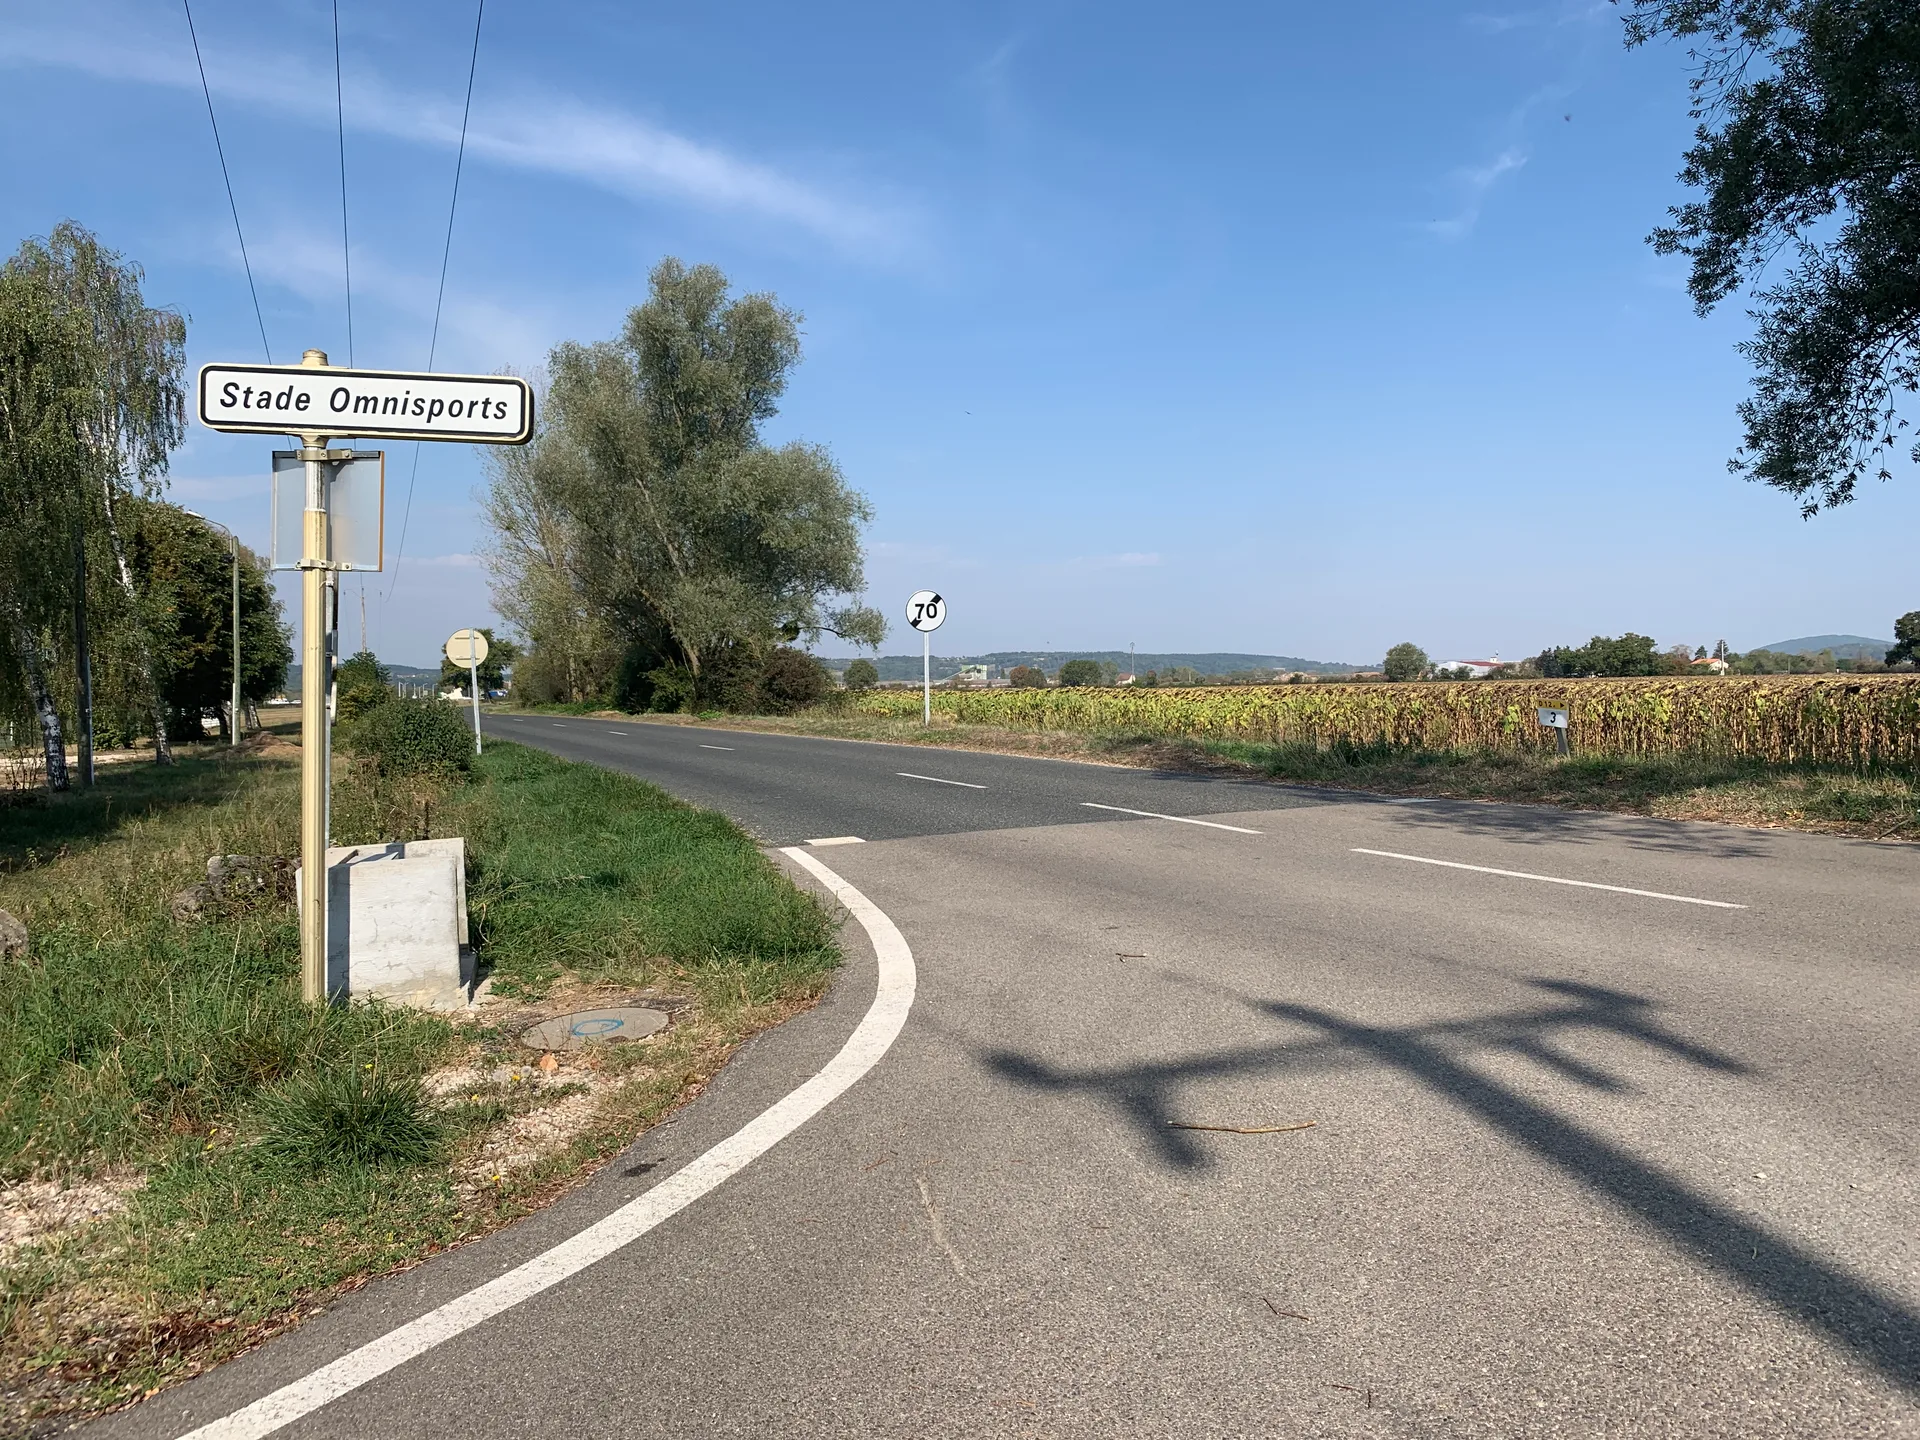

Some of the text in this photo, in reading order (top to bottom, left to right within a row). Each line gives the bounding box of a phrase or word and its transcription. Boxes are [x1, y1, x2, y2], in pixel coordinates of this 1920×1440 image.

[220, 382, 508, 423] Stade Omnisports
[914, 603, 937, 619] 70
[1550, 711, 1557, 723] 3
